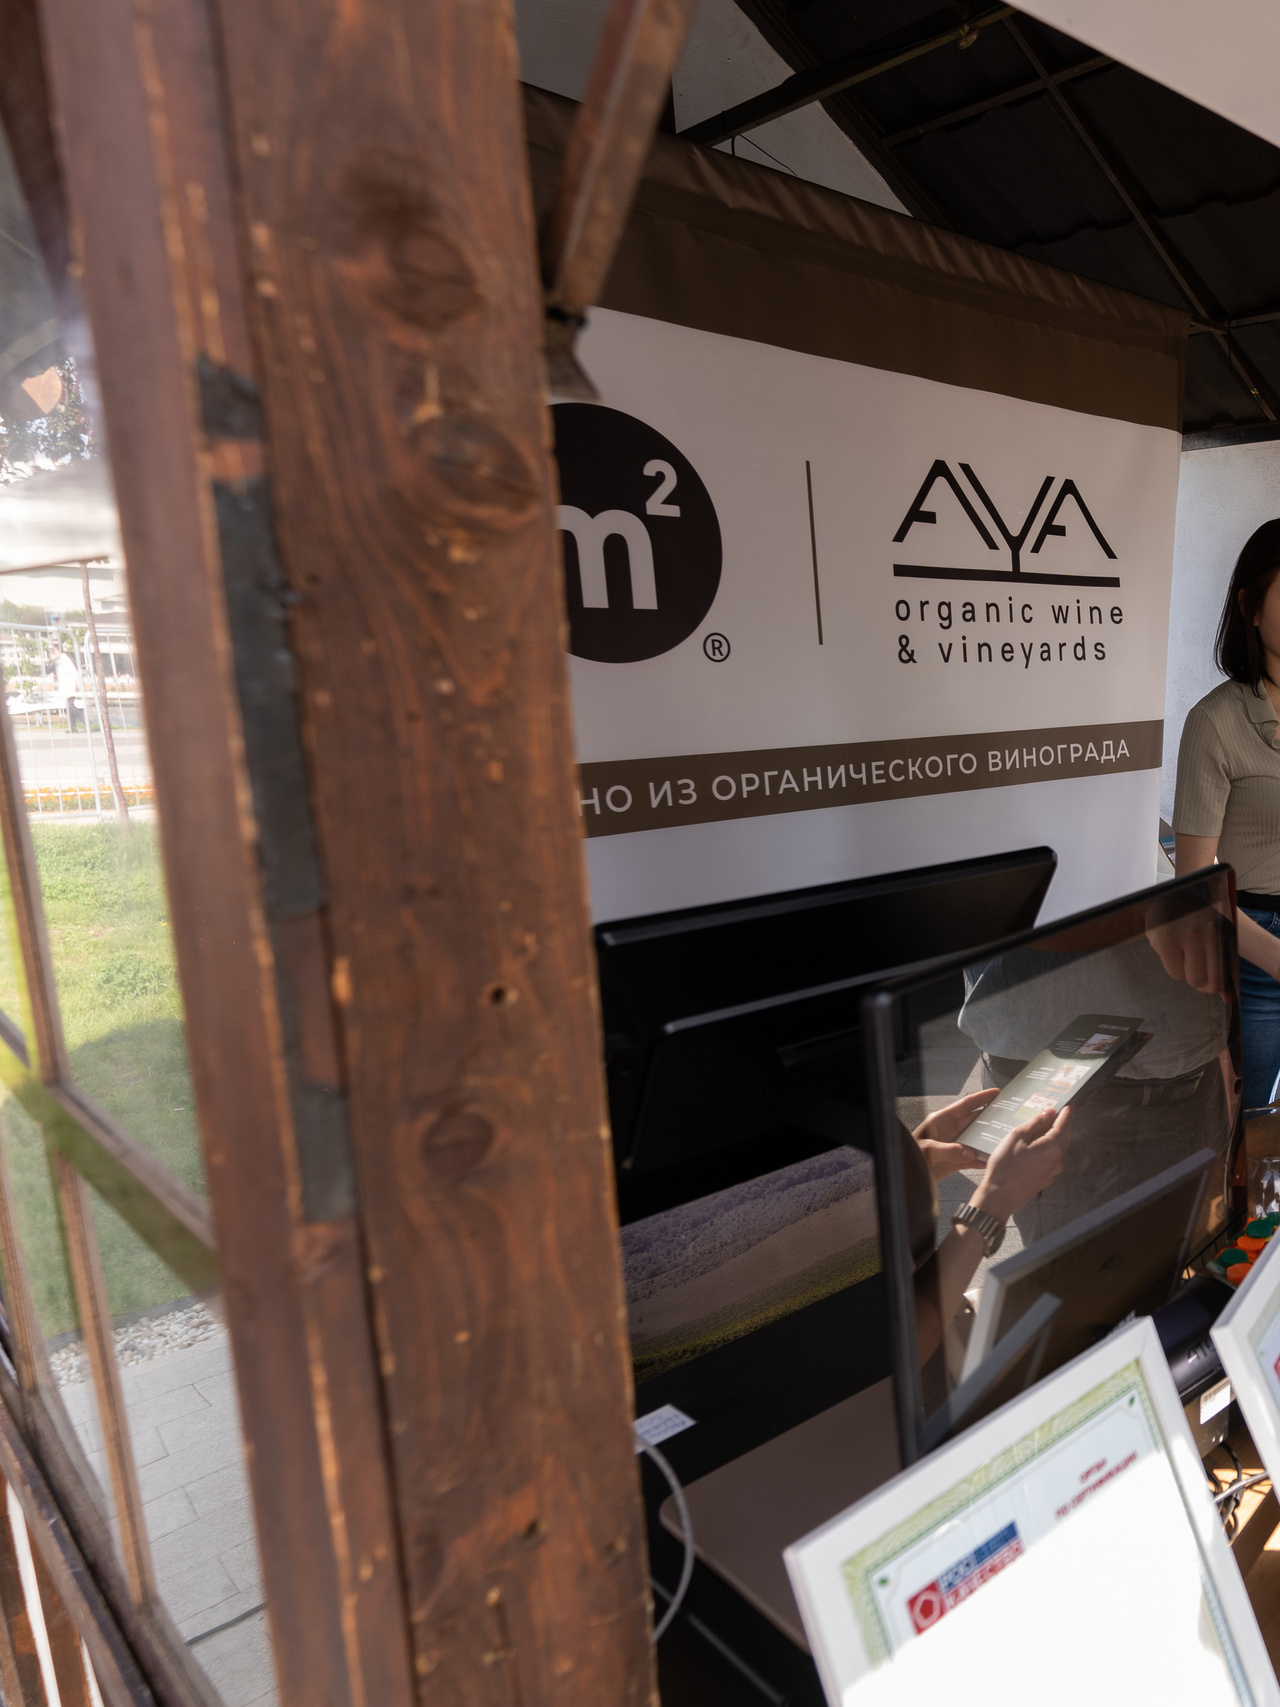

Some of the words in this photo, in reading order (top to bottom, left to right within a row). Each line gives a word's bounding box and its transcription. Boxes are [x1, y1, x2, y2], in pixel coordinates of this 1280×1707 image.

[895, 596, 1034, 629] organic
[1051, 600, 1124, 625] wine
[897, 635, 917, 664] &
[938, 636, 1107, 668] vineyards
[649, 778, 698, 808] ИЗ
[711, 752, 979, 801] ОРГАНИЧЕСКОГО
[987, 739, 1130, 774] ВИНОГРАДА
